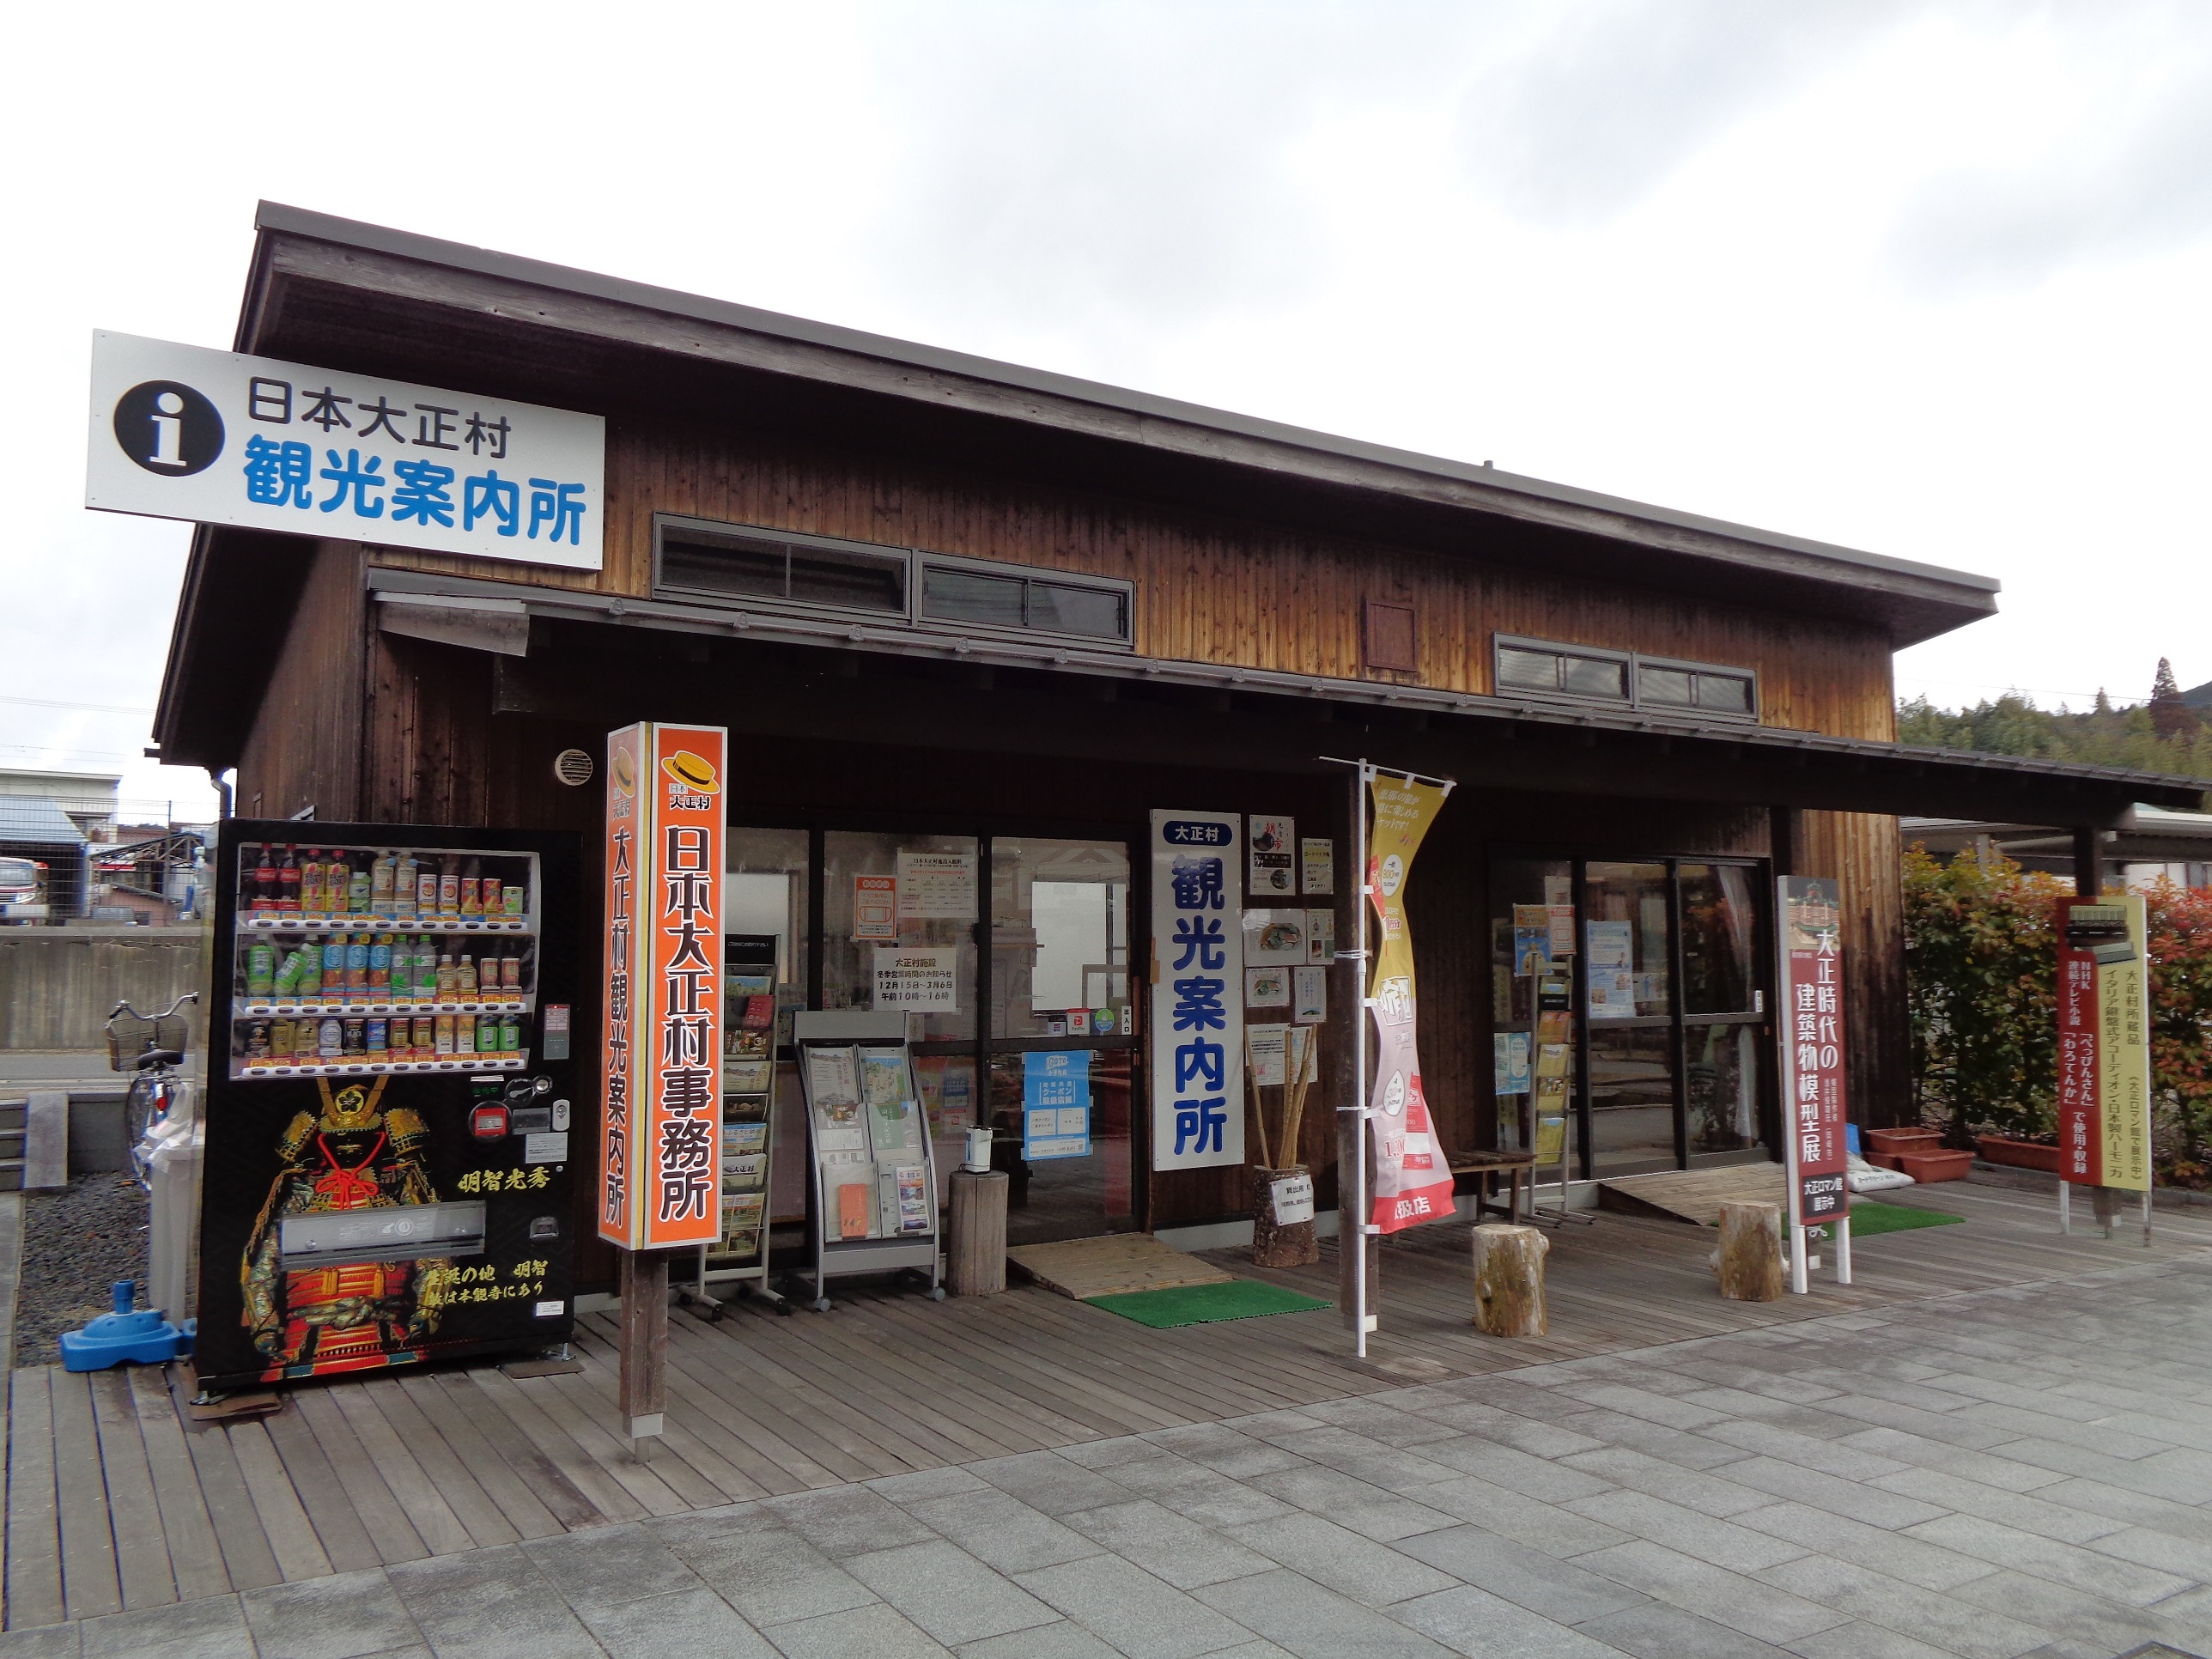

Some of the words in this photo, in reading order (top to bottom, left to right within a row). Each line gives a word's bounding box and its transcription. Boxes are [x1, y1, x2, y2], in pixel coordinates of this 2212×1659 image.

[249, 376, 511, 459] 日本大正村
[243, 434, 587, 545] 観光案内所
[670, 784, 687, 793] 日本
[669, 795, 712, 811] 大正村
[1175, 826, 1219, 842] 大正村
[1376, 817, 1410, 830] ケットです!
[877, 970, 952, 979] 冬季営業時間のお知らせ
[895, 958, 936, 968] 大正村施設
[2081, 961, 2091, 989] NHK
[1171, 854, 1227, 1155] 観光案内所
[1816, 928, 1839, 1070] 大正時代の
[2068, 961, 2081, 1025] 連続テレビ小説
[605, 824, 631, 1230] 大正村観光案内所
[659, 824, 715, 1222] 日本大正村事務所
[1796, 982, 1821, 1163] 建築物模型展
[457, 1166, 550, 1193] 明智光秀
[1804, 1176, 1843, 1195] 大正ロマン館
[1814, 1195, 1835, 1211] 展示中
[426, 1264, 496, 1286] 生誕の地
[513, 1259, 549, 1278] 明智
